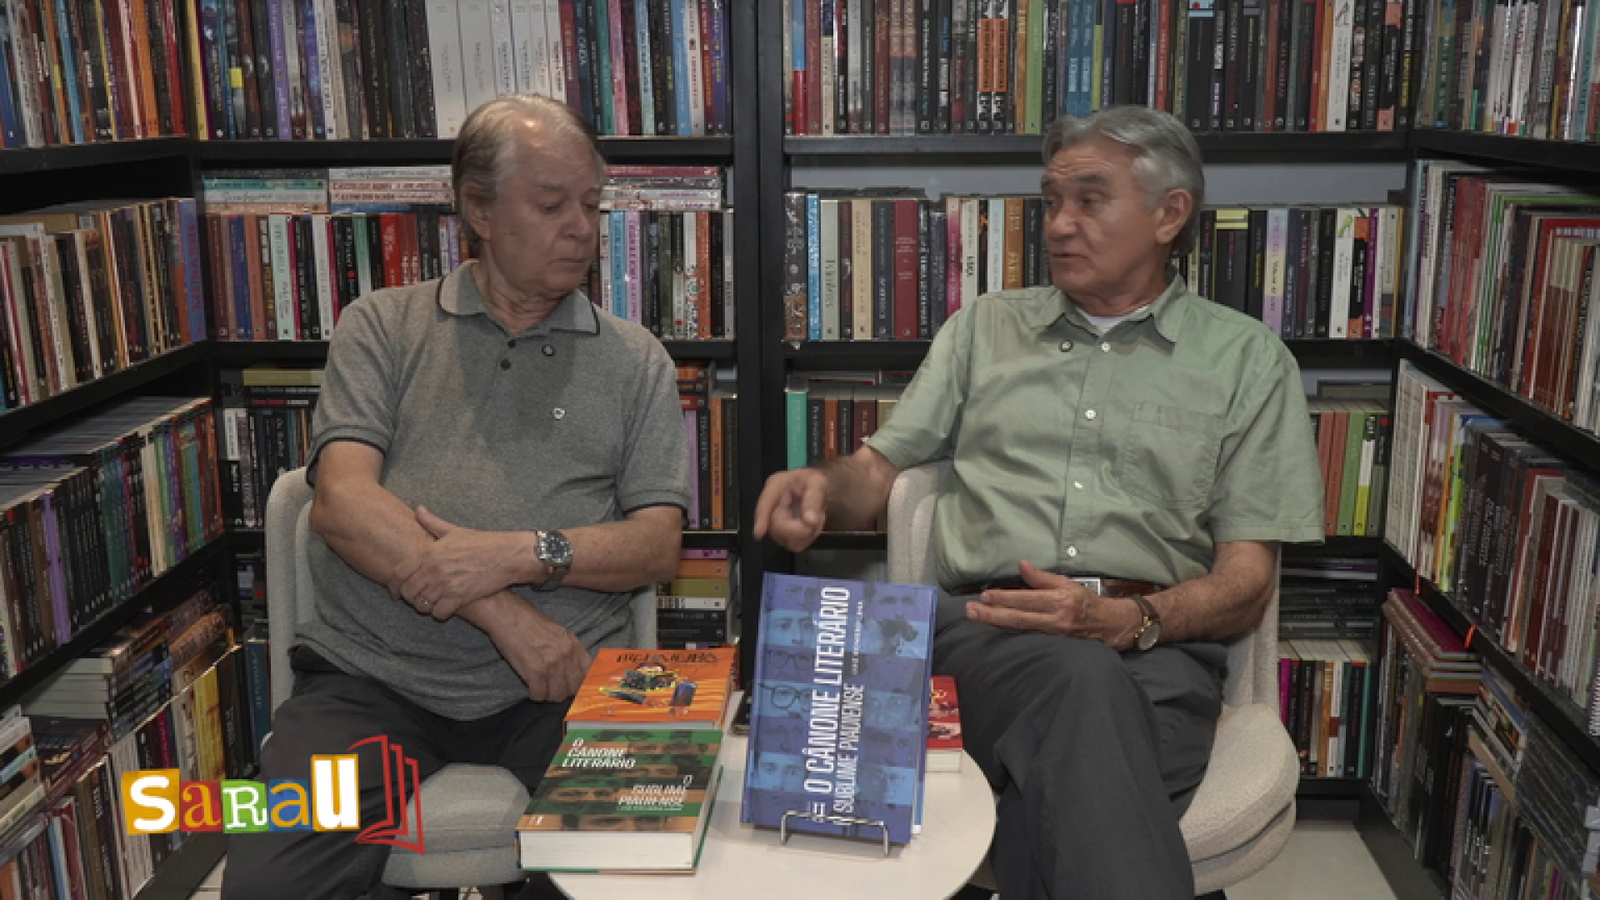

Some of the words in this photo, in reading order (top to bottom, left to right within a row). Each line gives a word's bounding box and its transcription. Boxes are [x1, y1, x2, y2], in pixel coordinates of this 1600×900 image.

[812, 587, 850, 686] LITERÁRIO
[801, 689, 841, 774] CÂNONE
[839, 683, 865, 751] PIAUIENSE
[803, 778, 833, 796] O
[833, 754, 859, 814] SUBLIME
